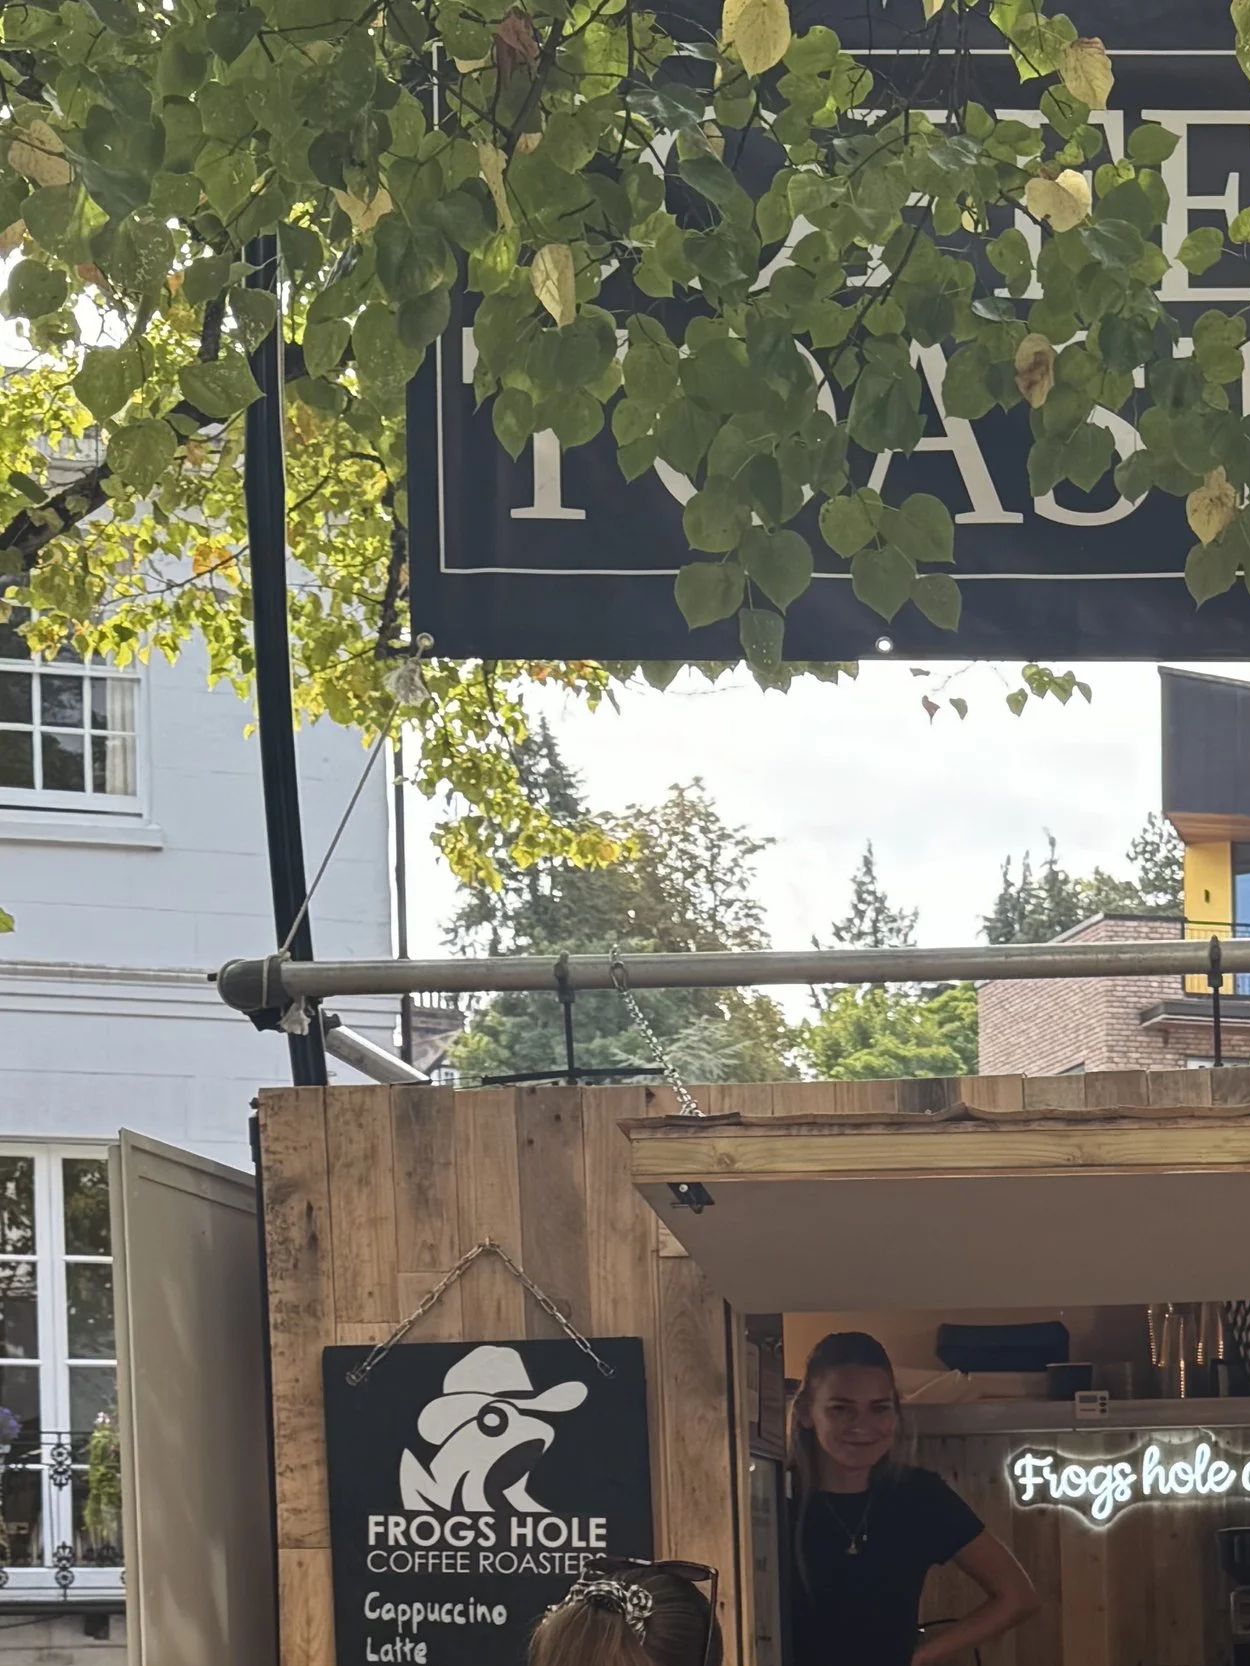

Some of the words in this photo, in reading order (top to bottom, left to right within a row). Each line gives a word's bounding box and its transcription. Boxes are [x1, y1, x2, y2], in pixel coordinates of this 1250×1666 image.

[1014, 1452, 1137, 1520] Frogs
[1142, 1443, 1237, 1495] hole
[368, 1515, 496, 1547] FROGS
[510, 1517, 607, 1548] HOLE
[367, 1551, 471, 1573] COFFEE
[364, 1591, 508, 1634] Cappuccino
[366, 1637, 428, 1664] Latte
